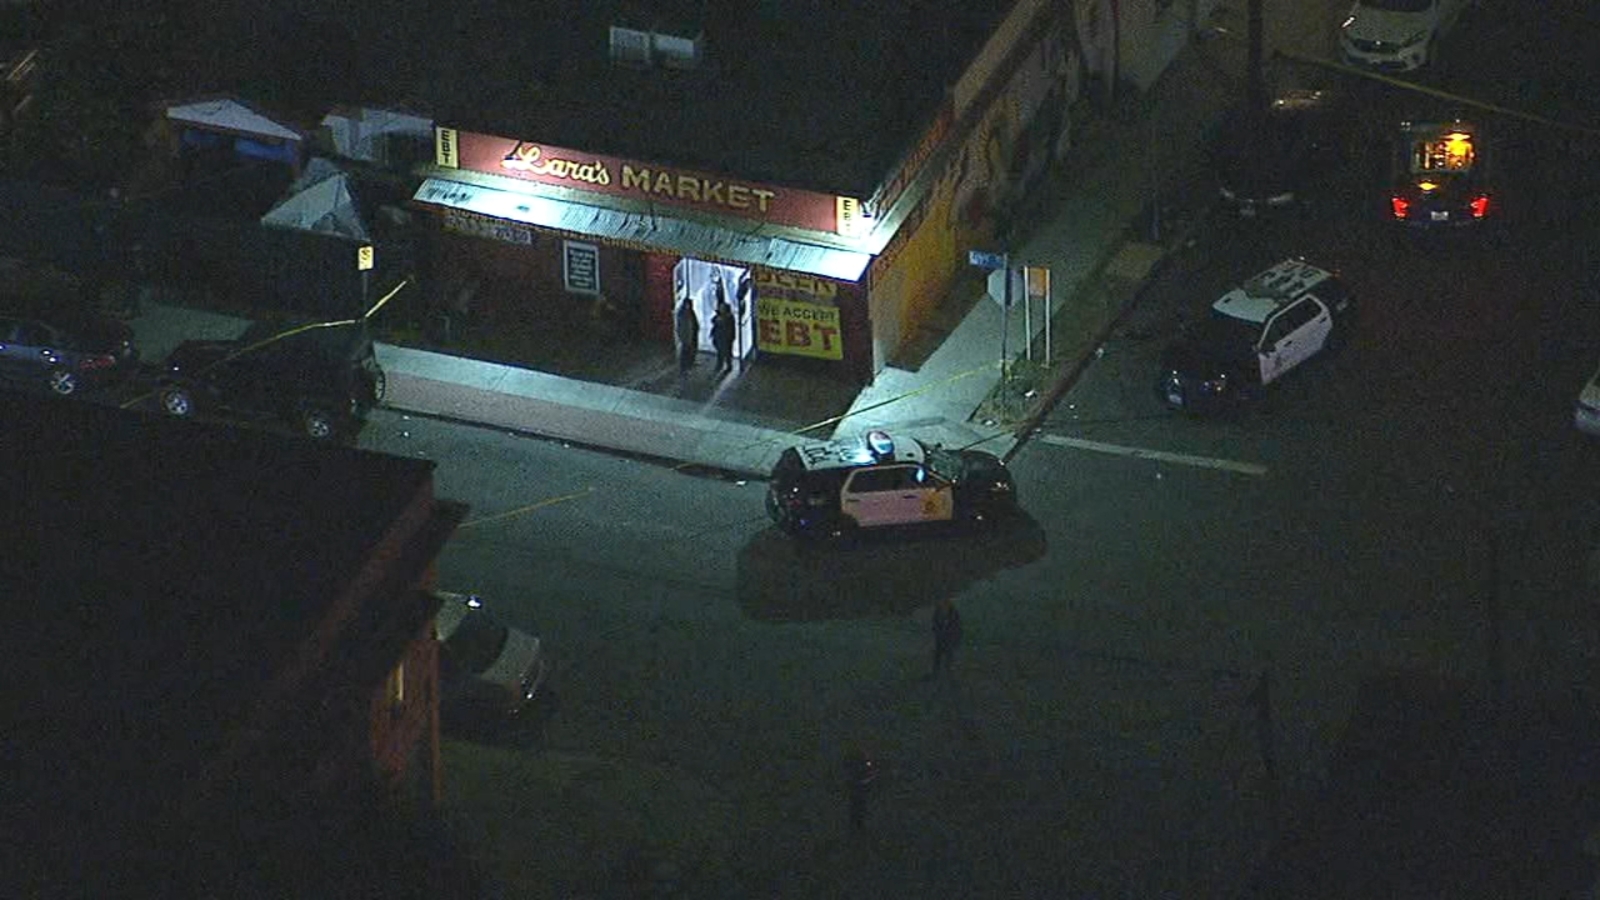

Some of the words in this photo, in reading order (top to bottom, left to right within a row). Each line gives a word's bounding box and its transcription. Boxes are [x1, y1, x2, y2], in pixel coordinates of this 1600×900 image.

[441, 129, 451, 164] EBT
[501, 144, 611, 186] Lara's
[621, 163, 776, 214] MARKET
[758, 302, 780, 316] WE
[783, 306, 836, 321] ACCEPT
[759, 318, 838, 351] EBT
